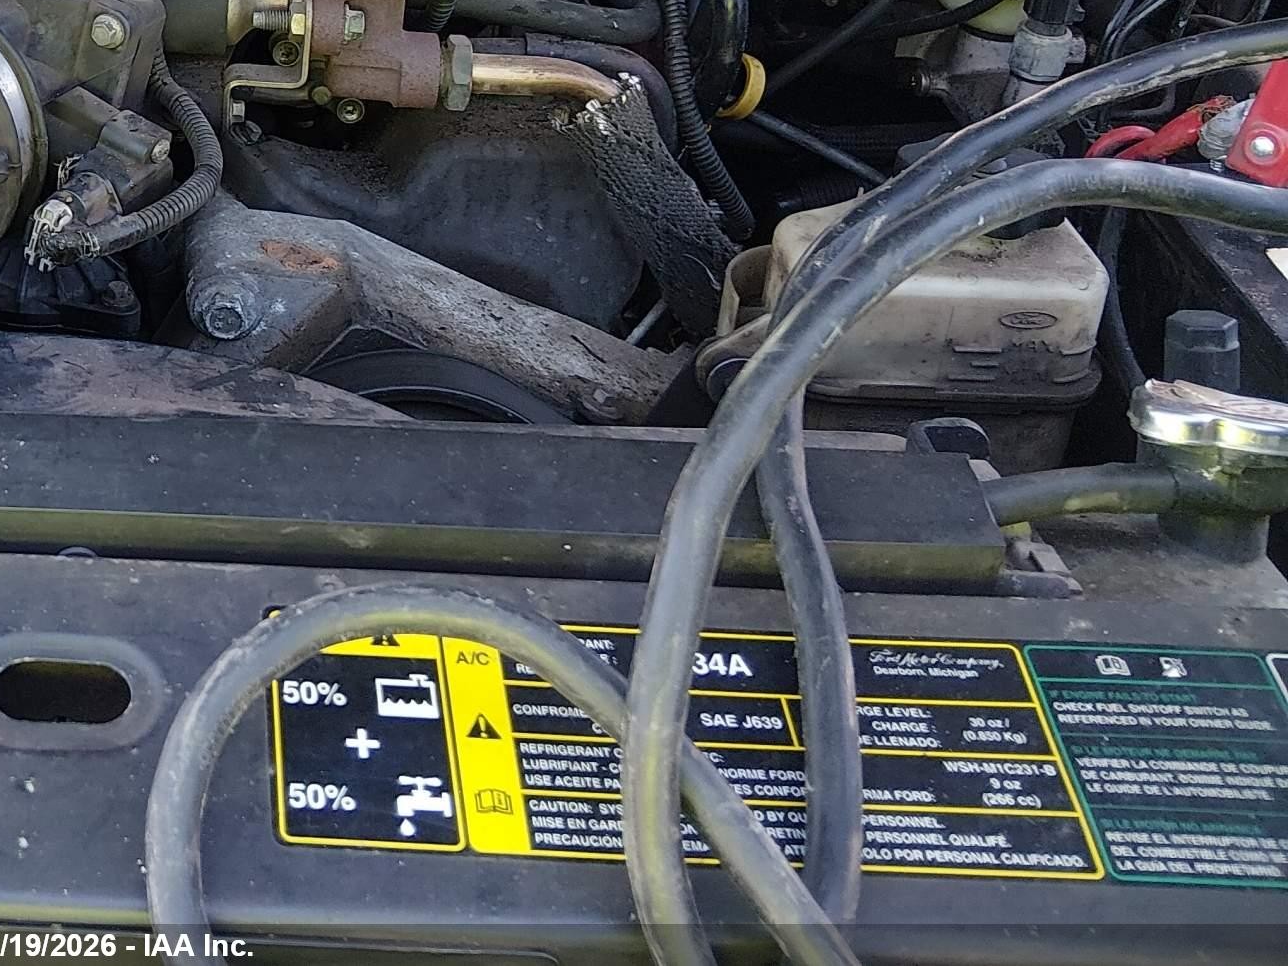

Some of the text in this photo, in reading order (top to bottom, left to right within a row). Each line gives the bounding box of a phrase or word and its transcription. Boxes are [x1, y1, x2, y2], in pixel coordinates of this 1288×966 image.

[456, 650, 491, 666] A/C
[691, 652, 754, 677] 34A
[928, 667, 979, 679] Michigan
[283, 680, 348, 706] 50%
[884, 707, 932, 719] LEVEL:
[1052, 701, 1096, 712] CHECK
[1096, 702, 1128, 713] FUEL
[700, 712, 784, 729] SAE J639
[872, 720, 930, 733] CHARGE
[968, 717, 986, 728] 30
[1057, 714, 1138, 726] REFERENCED
[1152, 716, 1188, 727] YOUR
[1187, 717, 1234, 729] OWNER
[873, 735, 943, 748] LLENADO:
[519, 742, 611, 759] REFRIGERANT
[522, 758, 599, 773] LUBRIFIANT
[524, 774, 552, 787] USE
[554, 775, 601, 789] ACEITE
[718, 767, 767, 781] NORME
[989, 777, 1023, 790] 9 oz
[289, 782, 357, 812] 50%
[895, 790, 937, 803] FORD:
[528, 799, 624, 817] CAUTION: SYS
[531, 816, 624, 832] MISE EN GARD
[766, 810, 786, 823] BY
[865, 830, 950, 846] PERSONNEL
[862, 847, 1089, 868] OLO POR PERSONAL CALIFICADO.
